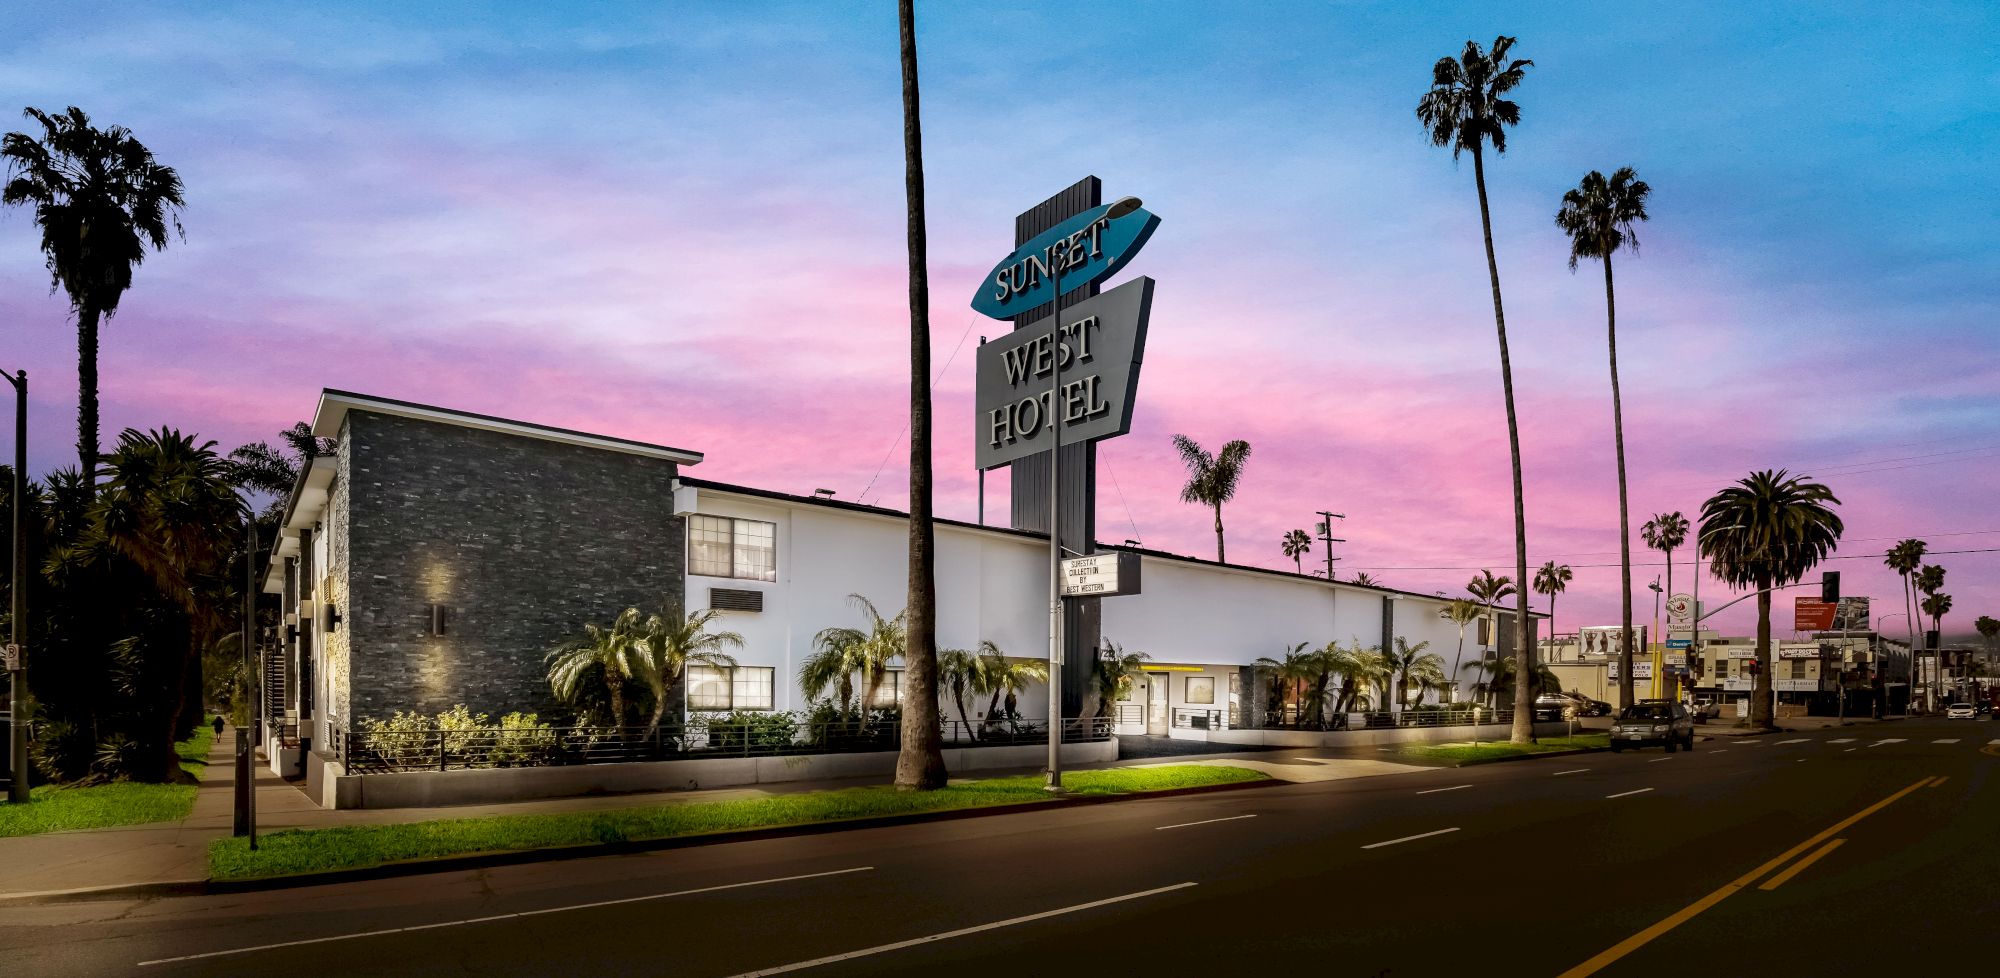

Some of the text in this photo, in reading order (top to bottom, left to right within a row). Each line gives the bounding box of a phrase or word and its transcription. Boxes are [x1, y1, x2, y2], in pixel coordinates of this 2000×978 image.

[995, 219, 1106, 301] SUNSET
[1000, 315, 1097, 385] WEST
[989, 374, 1107, 445] HOTEL
[1071, 558, 1097, 568] SURESTAY
[1069, 566, 1099, 577] COLLECTION
[1079, 576, 1087, 584] BY
[1066, 583, 1105, 593] BEST WESTERN
